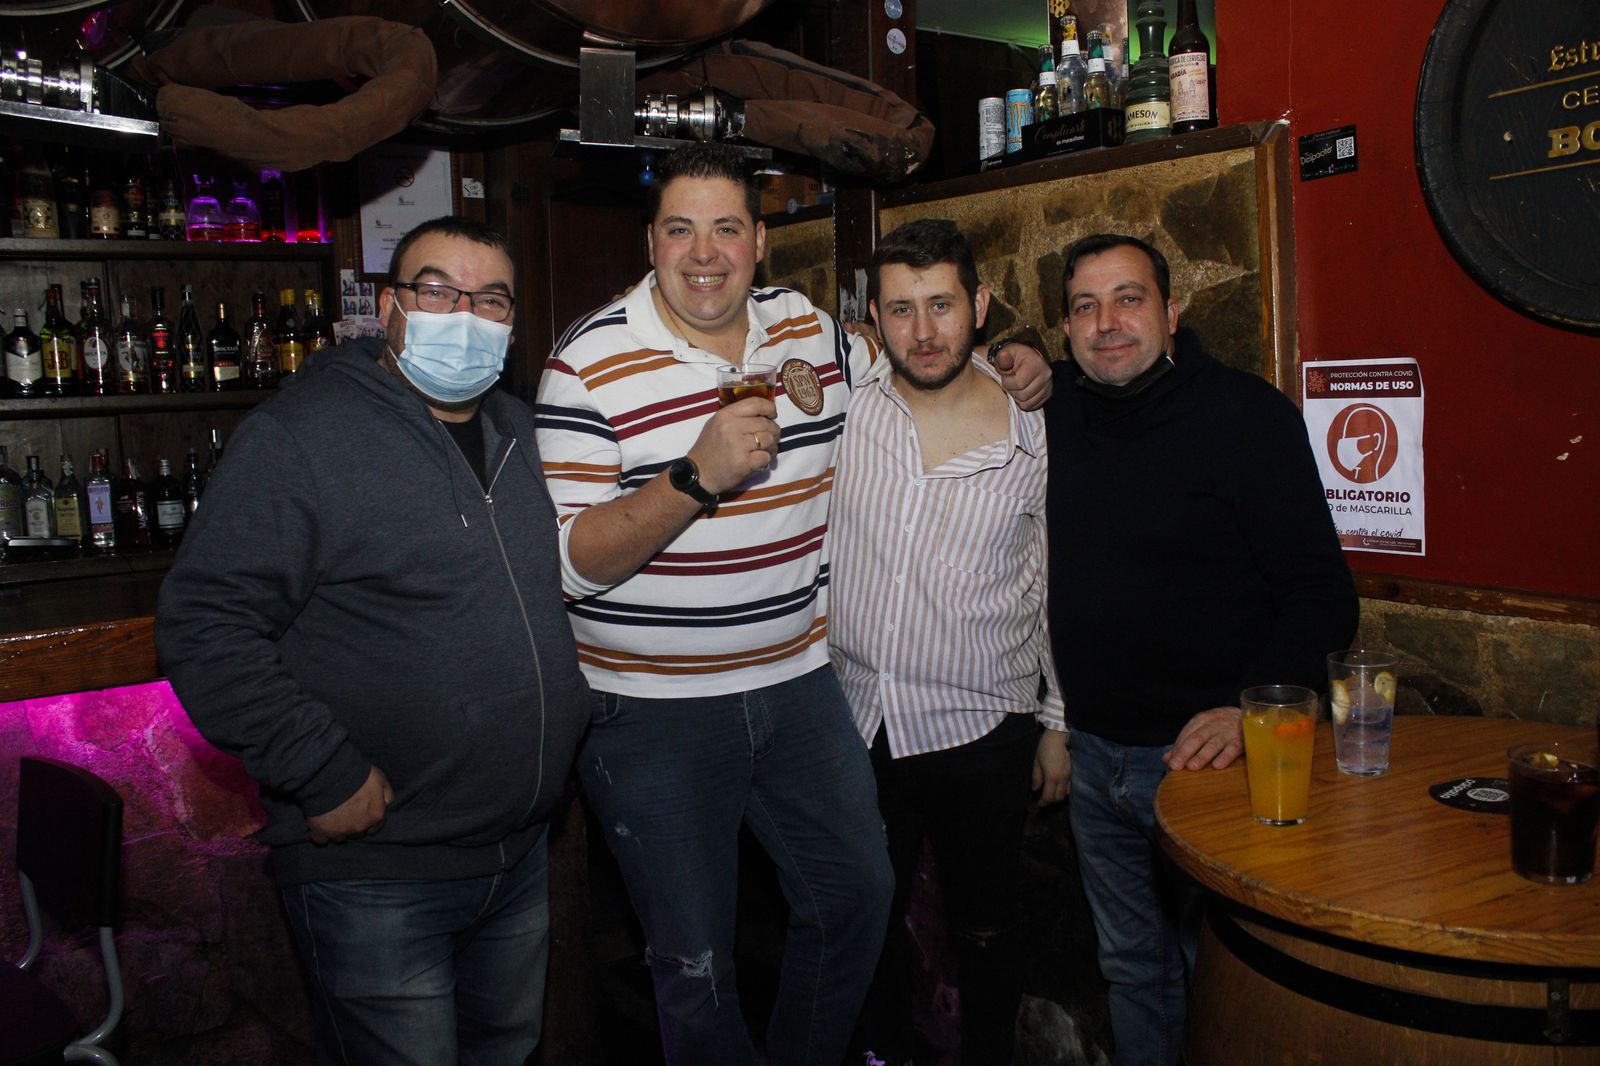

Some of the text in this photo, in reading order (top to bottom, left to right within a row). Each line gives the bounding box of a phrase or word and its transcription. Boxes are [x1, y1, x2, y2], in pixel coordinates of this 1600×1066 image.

[1330, 371, 1368, 379] PROTECCIÓN
[1330, 381, 1414, 391] NORMAS DE USO
[1326, 489, 1411, 503] BLIGATORIO
[1336, 503, 1348, 512] de
[1350, 505, 1412, 516] MASCARILLA
[1346, 528, 1368, 536] contra
[1380, 528, 1403, 538] covid
